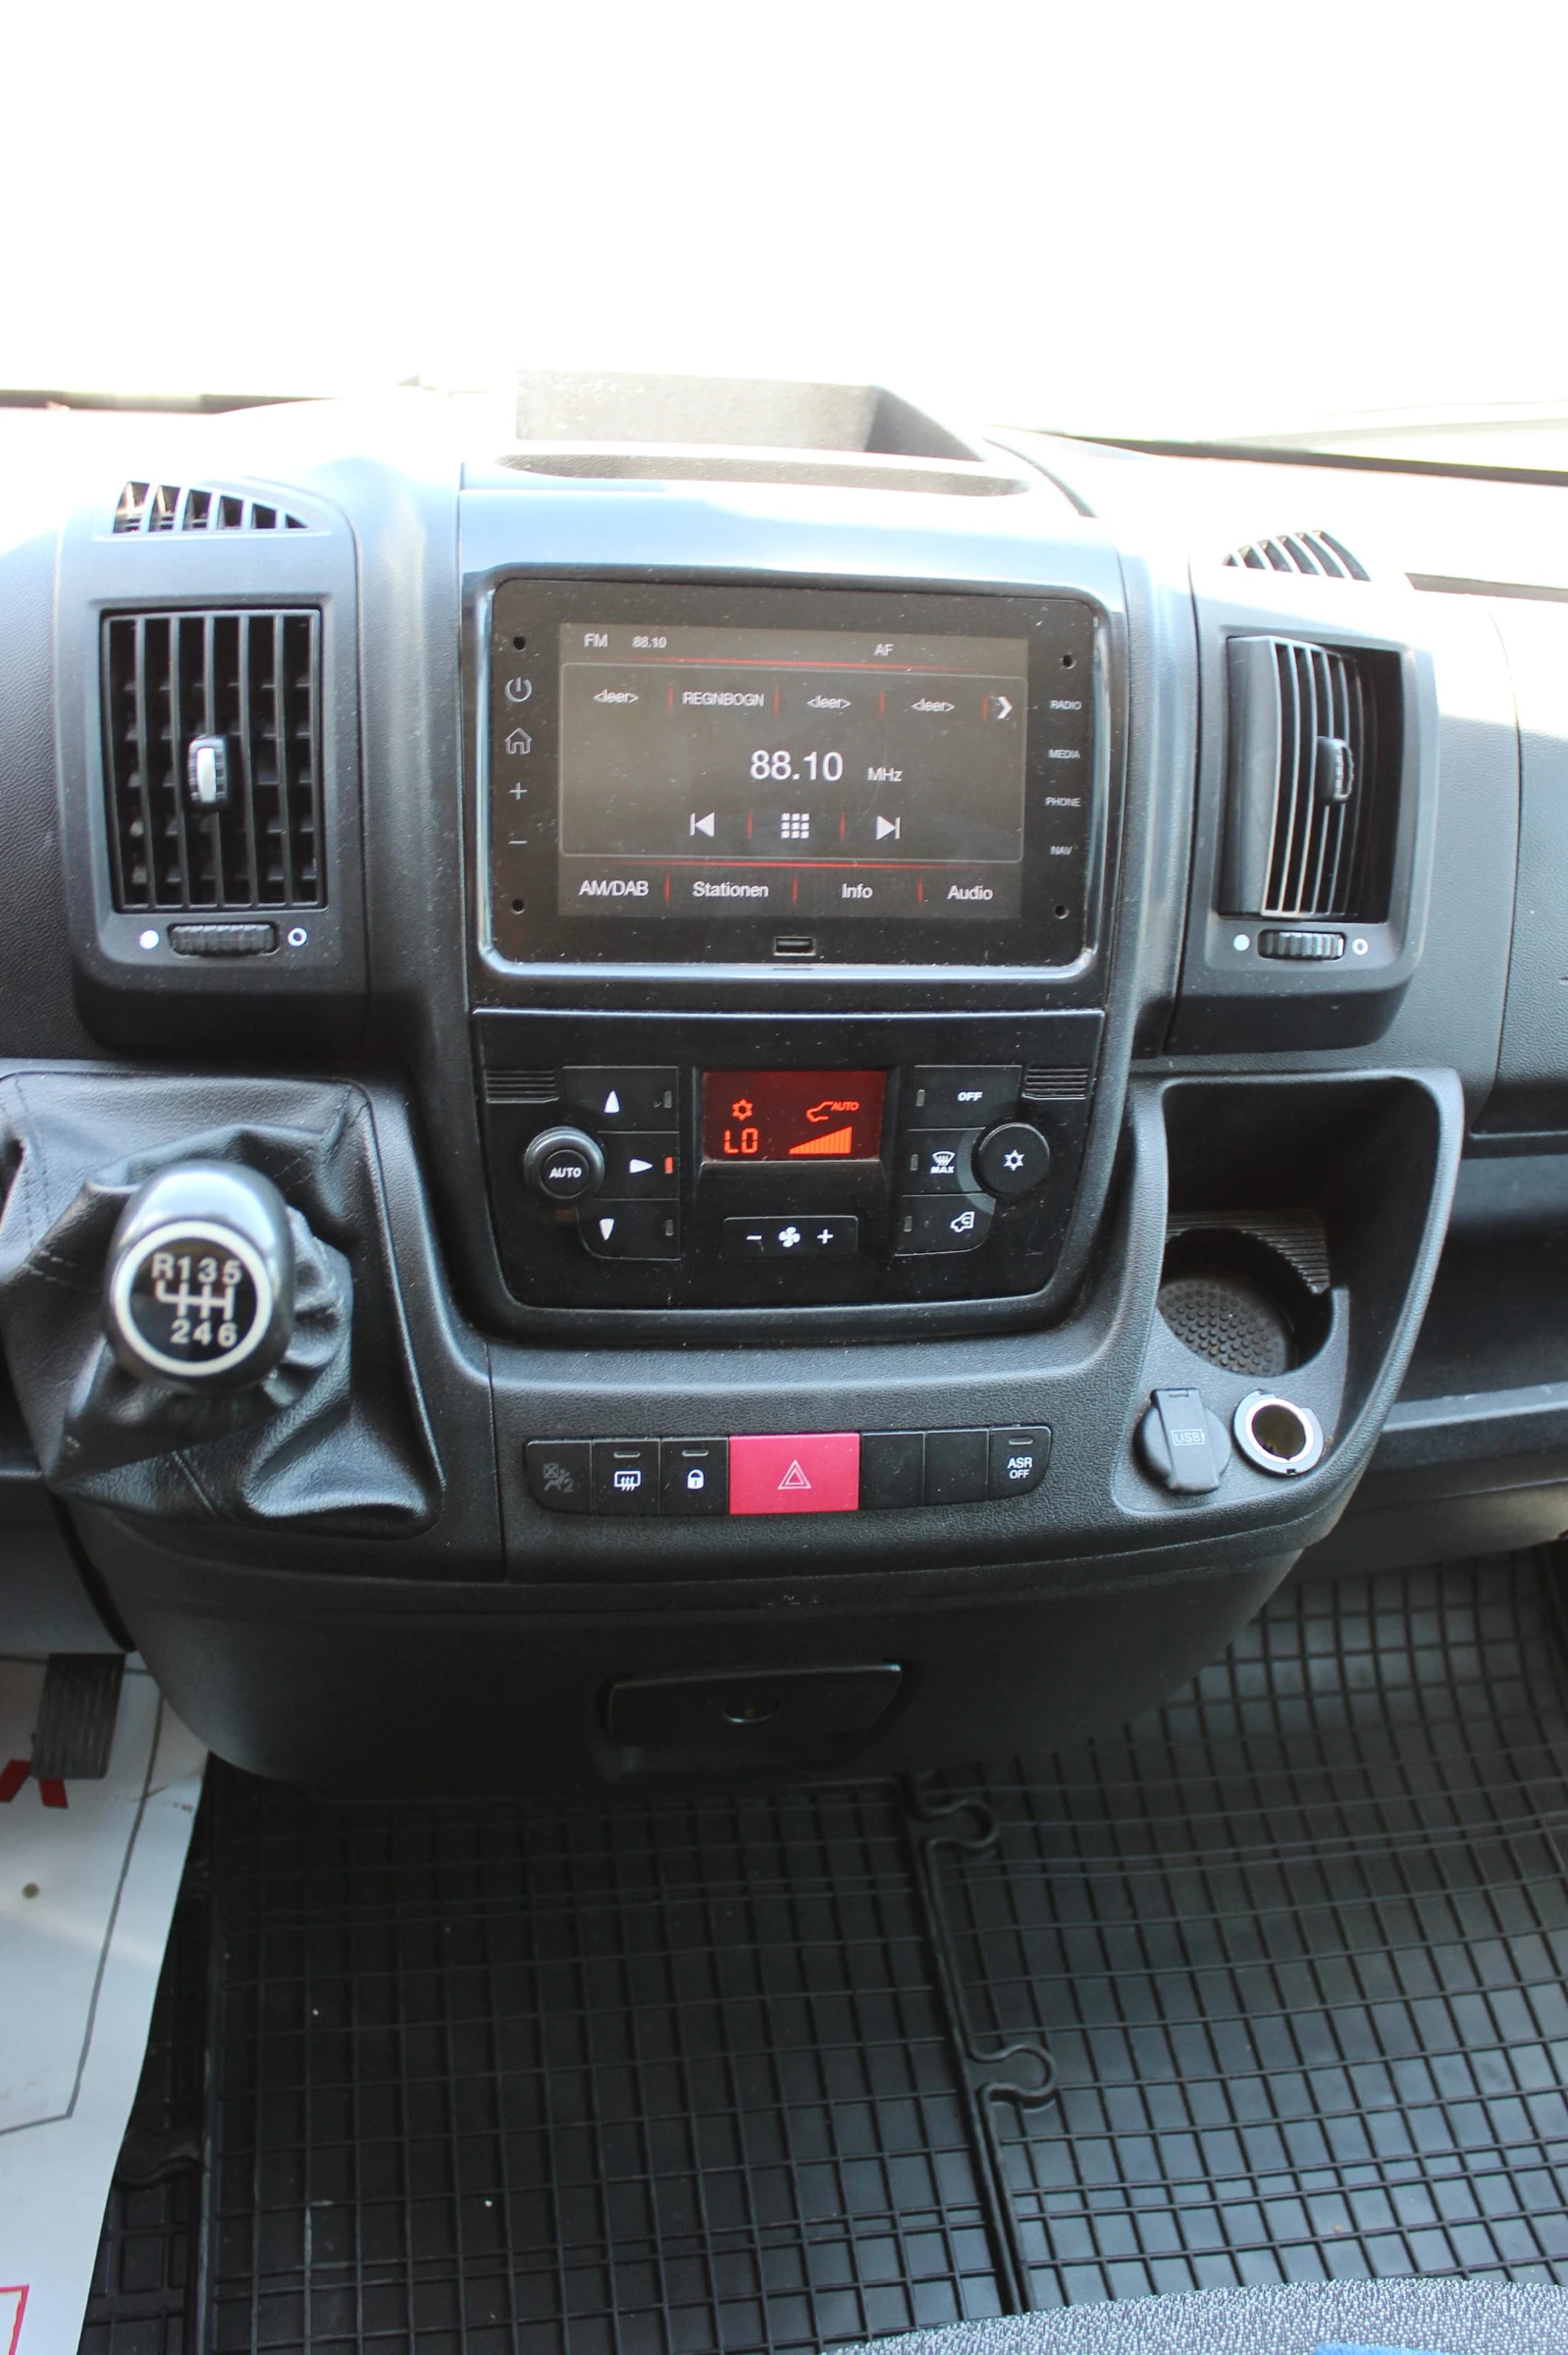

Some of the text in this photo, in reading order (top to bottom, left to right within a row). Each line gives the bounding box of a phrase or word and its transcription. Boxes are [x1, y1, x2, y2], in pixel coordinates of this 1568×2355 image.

[583, 633, 667, 649] FM 88.10
[873, 644, 894, 656] AF
[682, 691, 764, 706] REGNBOGN
[1050, 700, 1082, 710] RADIO
[1048, 749, 1081, 759] MEDIA
[750, 750, 903, 782] 88.10 MHz
[1045, 796, 1081, 808] PHONE
[1050, 845, 1072, 856] NAV
[578, 880, 650, 897] AM/DAB
[692, 880, 769, 898] Stationen
[841, 883, 873, 900] Info
[947, 885, 994, 901] Audio
[957, 1091, 983, 1102] OFF
[830, 1100, 860, 1112] AUTO
[549, 1166, 583, 1178] AUTO
[929, 1166, 955, 1175] MAX
[1174, 1433, 1201, 1444] USB
[1007, 1456, 1033, 1470] ASR
[1009, 1469, 1030, 1480] OFF
